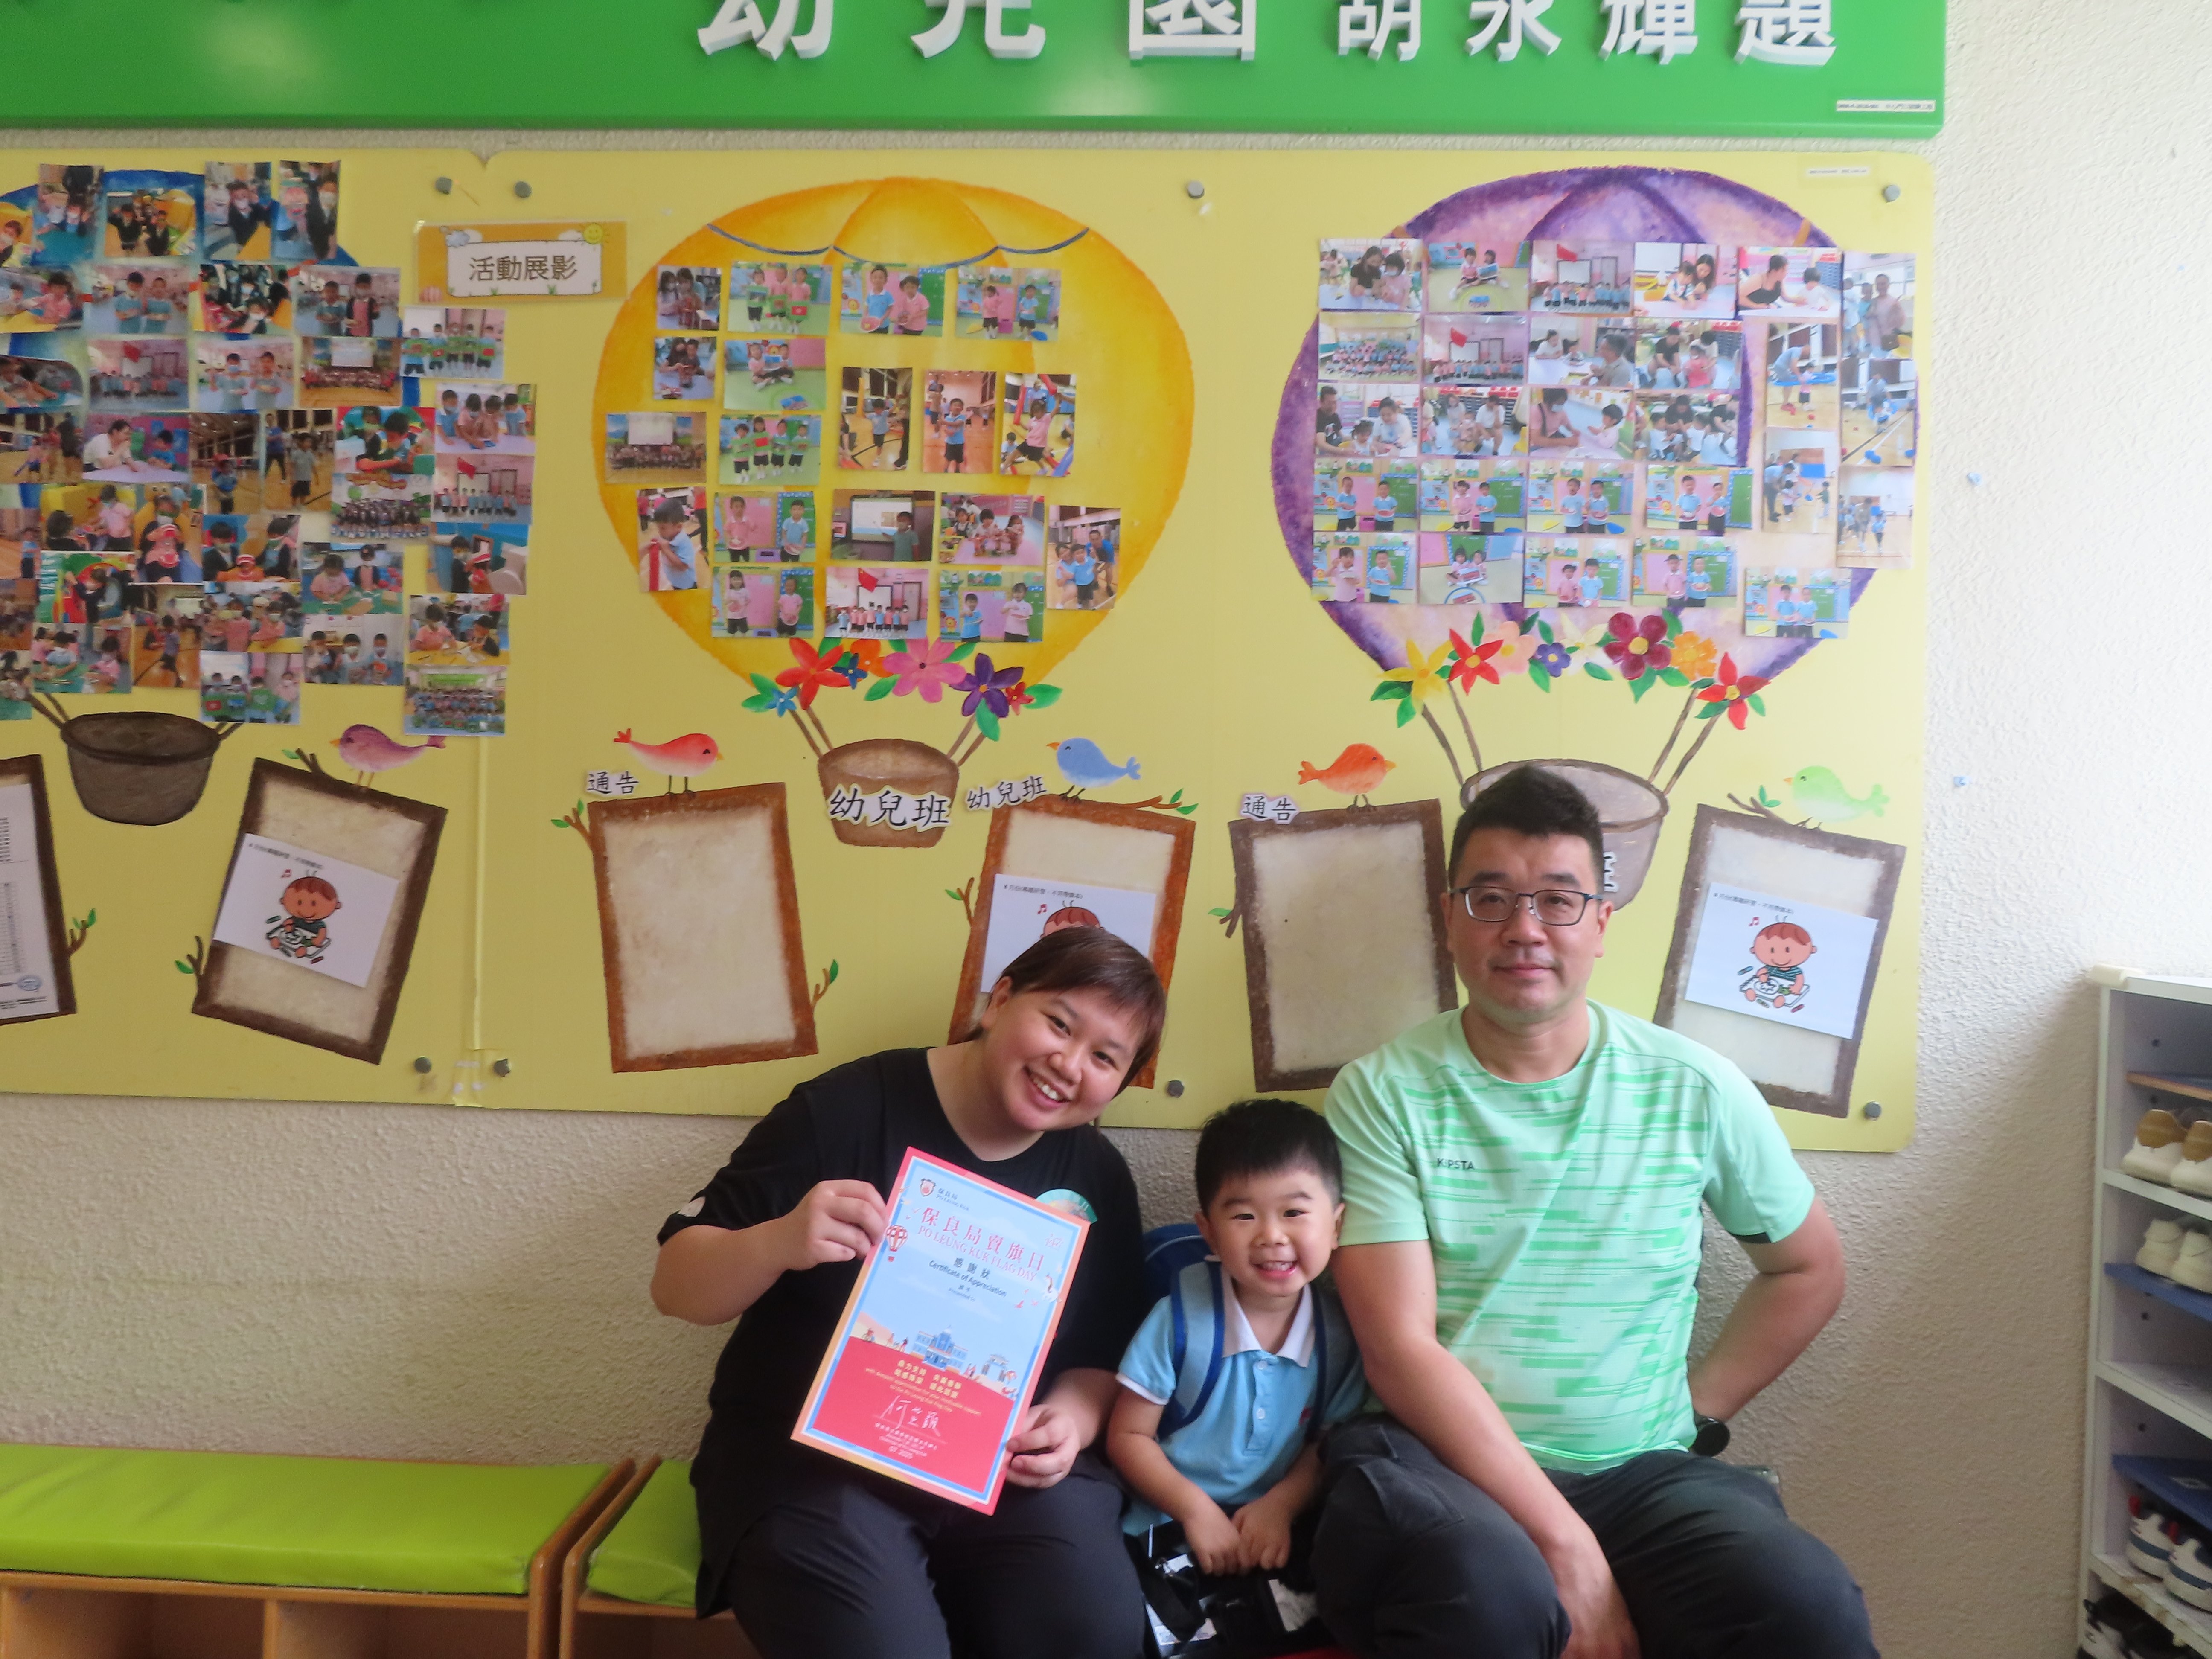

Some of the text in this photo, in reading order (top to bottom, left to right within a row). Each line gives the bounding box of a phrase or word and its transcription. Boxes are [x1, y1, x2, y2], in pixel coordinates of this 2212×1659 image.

[469, 255, 577, 282] 活動展影
[587, 771, 639, 794] 通告
[967, 776, 1048, 808] 幼兒班
[830, 788, 950, 828] 幼兒班
[1242, 796, 1296, 821] 通告
[918, 1225, 1037, 1281] PO LEUNG KUK FLAG DAY
[921, 1207, 1044, 1271] 保良局賣旗日
[929, 1260, 960, 1278] Certificate
[968, 1276, 1007, 1298] Appreciation
